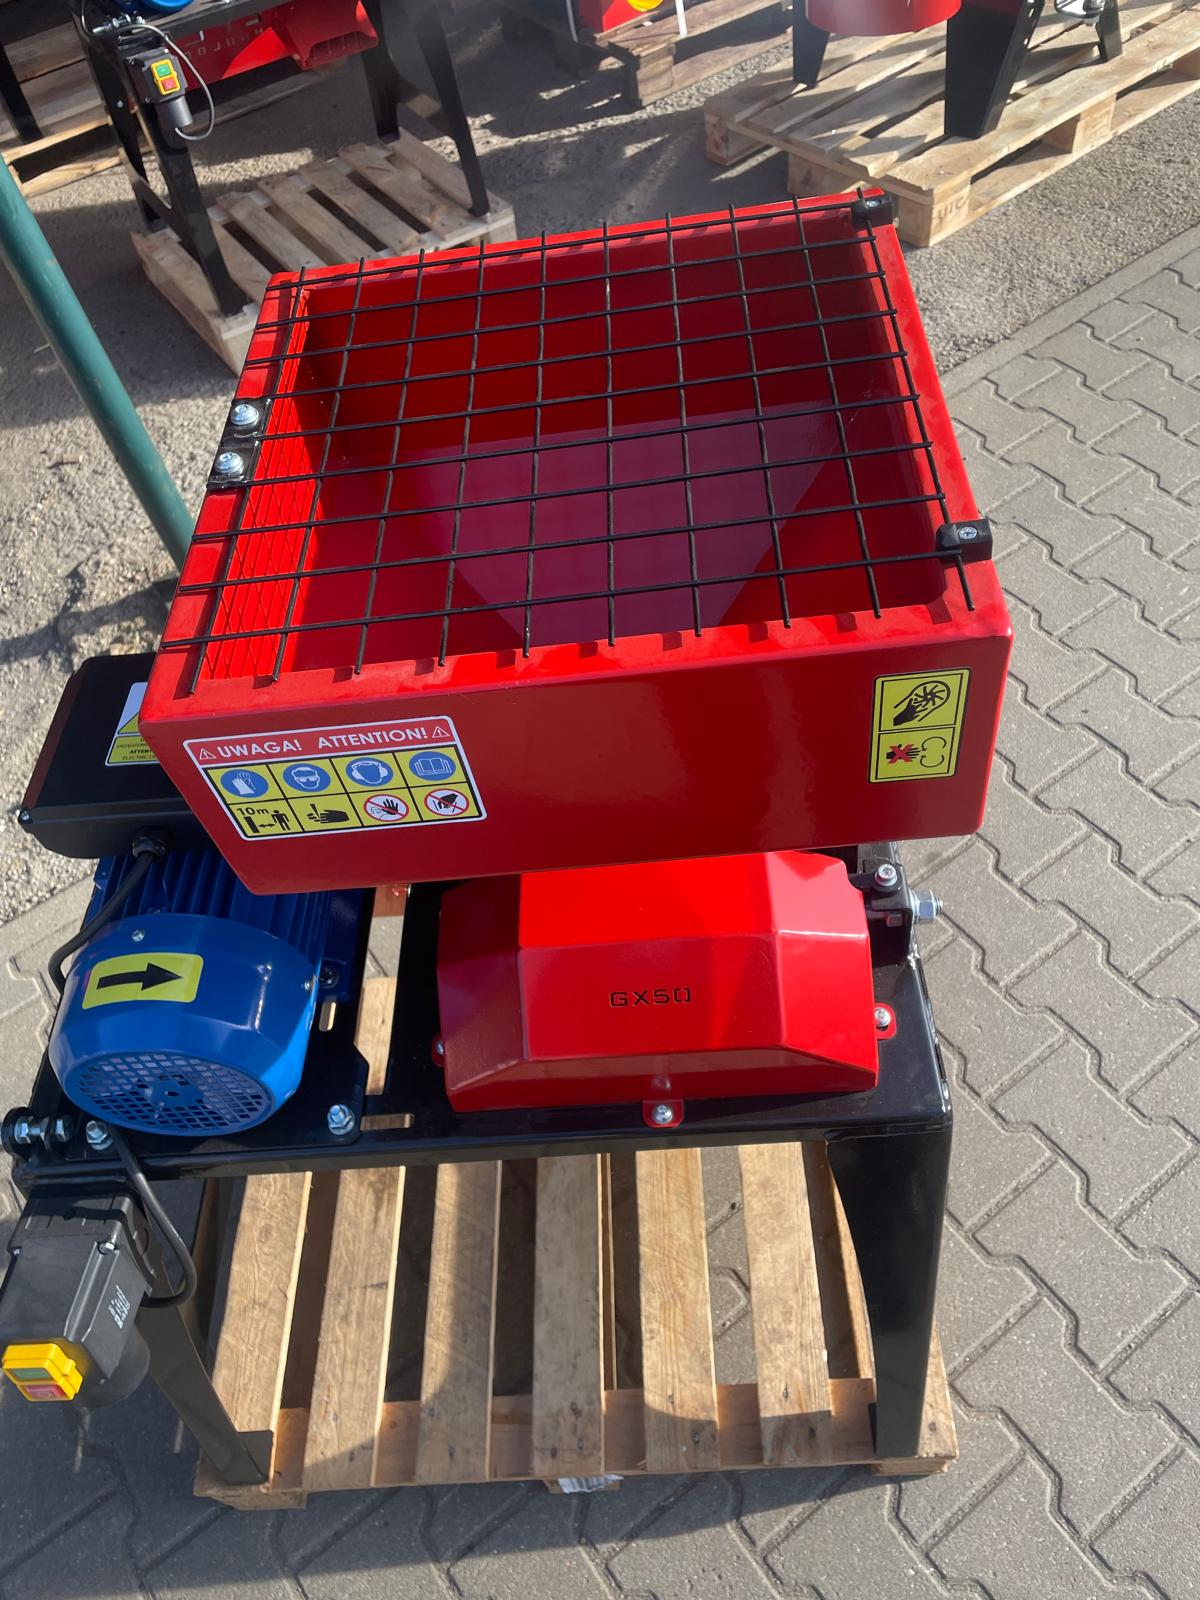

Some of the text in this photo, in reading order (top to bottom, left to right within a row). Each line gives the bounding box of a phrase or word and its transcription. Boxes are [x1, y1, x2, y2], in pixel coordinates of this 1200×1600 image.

[217, 727, 428, 759] UWAGA! ATTENTION!
[236, 805, 269, 817] 10m
[610, 987, 691, 1007] GX50
